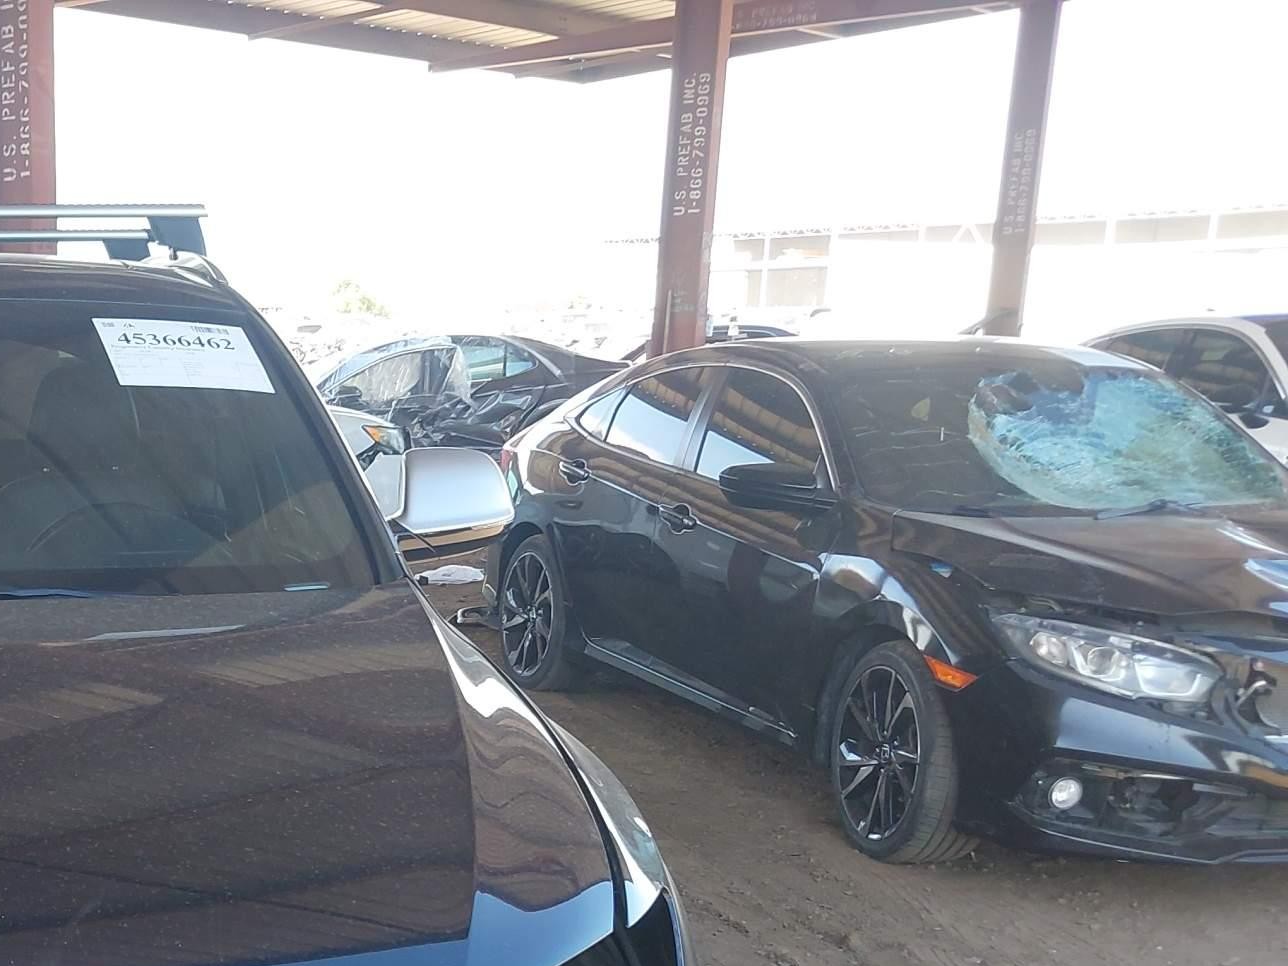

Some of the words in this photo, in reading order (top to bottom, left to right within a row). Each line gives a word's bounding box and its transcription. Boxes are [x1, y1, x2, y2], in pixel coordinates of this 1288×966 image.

[1, 24, 16, 120] PREFAB
[684, 72, 697, 104] INC.
[3, 135, 17, 182] U.S.
[677, 112, 693, 176] PREFAB
[688, 72, 711, 214] 1-866-799-0969
[117, 332, 236, 350] 45366462
